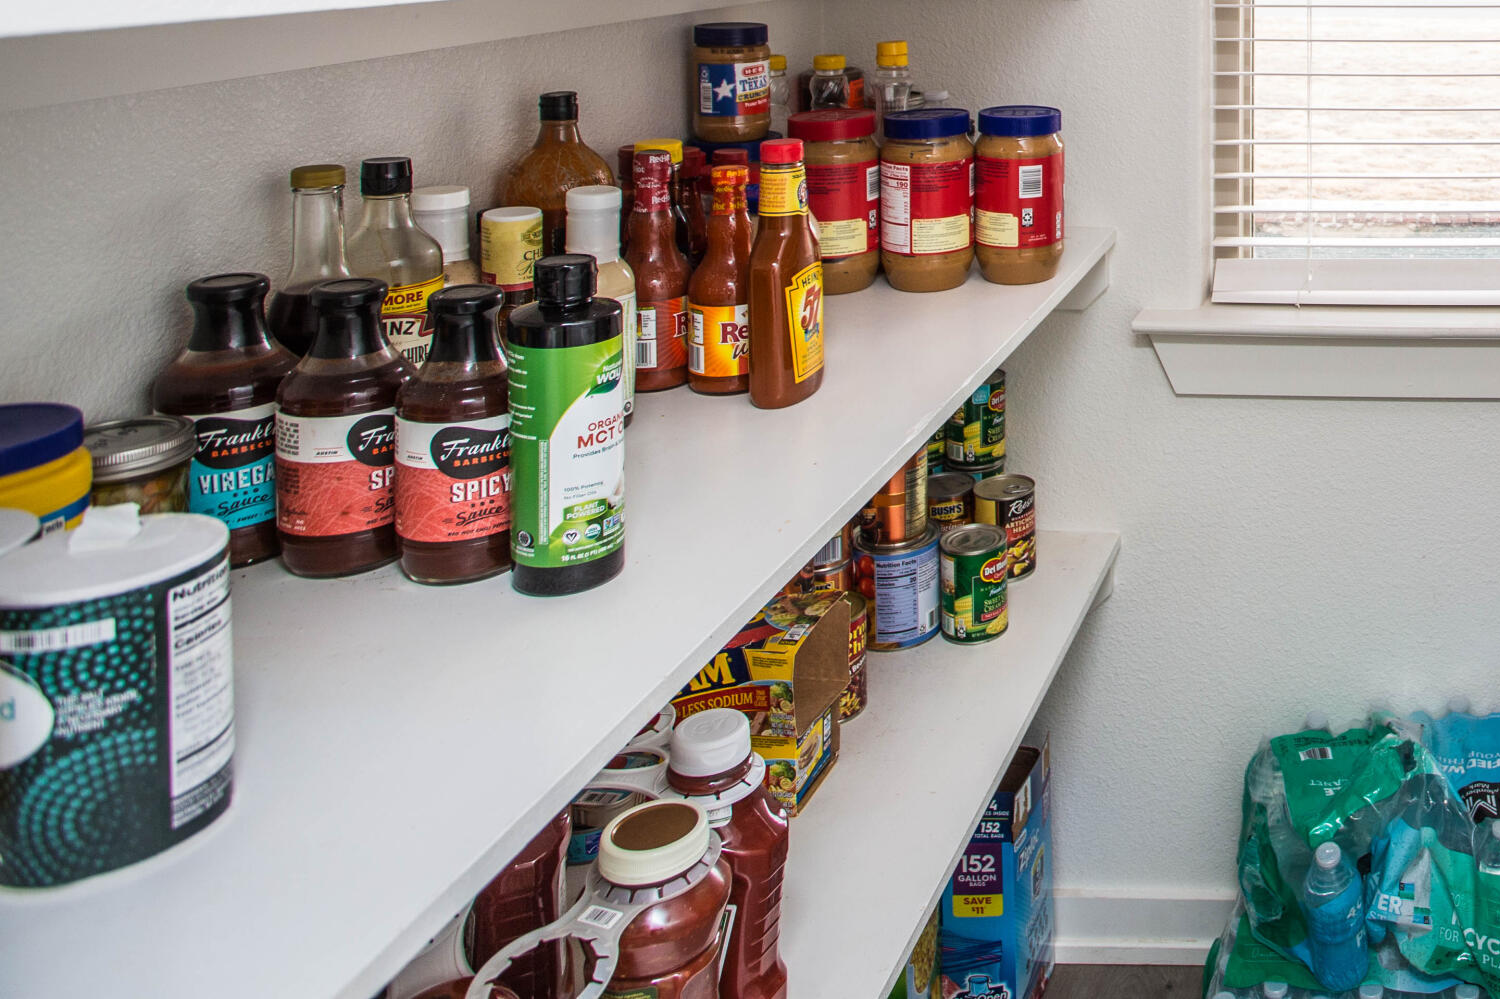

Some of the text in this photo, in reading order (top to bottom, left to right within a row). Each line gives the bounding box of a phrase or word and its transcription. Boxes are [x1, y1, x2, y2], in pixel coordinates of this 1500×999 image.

[739, 74, 768, 92] TEXAS
[383, 289, 424, 307] MORE
[577, 425, 616, 449] MCT
[217, 493, 272, 517] Sauce
[566, 504, 606, 520] POWERED
[573, 500, 600, 512] PLANT
[930, 502, 964, 517] BUSH'S
[456, 504, 506, 527] Sauce
[876, 558, 917, 569] Nutrition Facts
[984, 564, 996, 576] Del
[681, 692, 753, 718] LESS SODIUM
[980, 821, 1001, 833] 152
[960, 854, 996, 873] 152
[957, 874, 997, 882] GALLON
[963, 897, 992, 905] SAVE
[971, 906, 985, 915] $11
[1439, 926, 1460, 943] FOR
